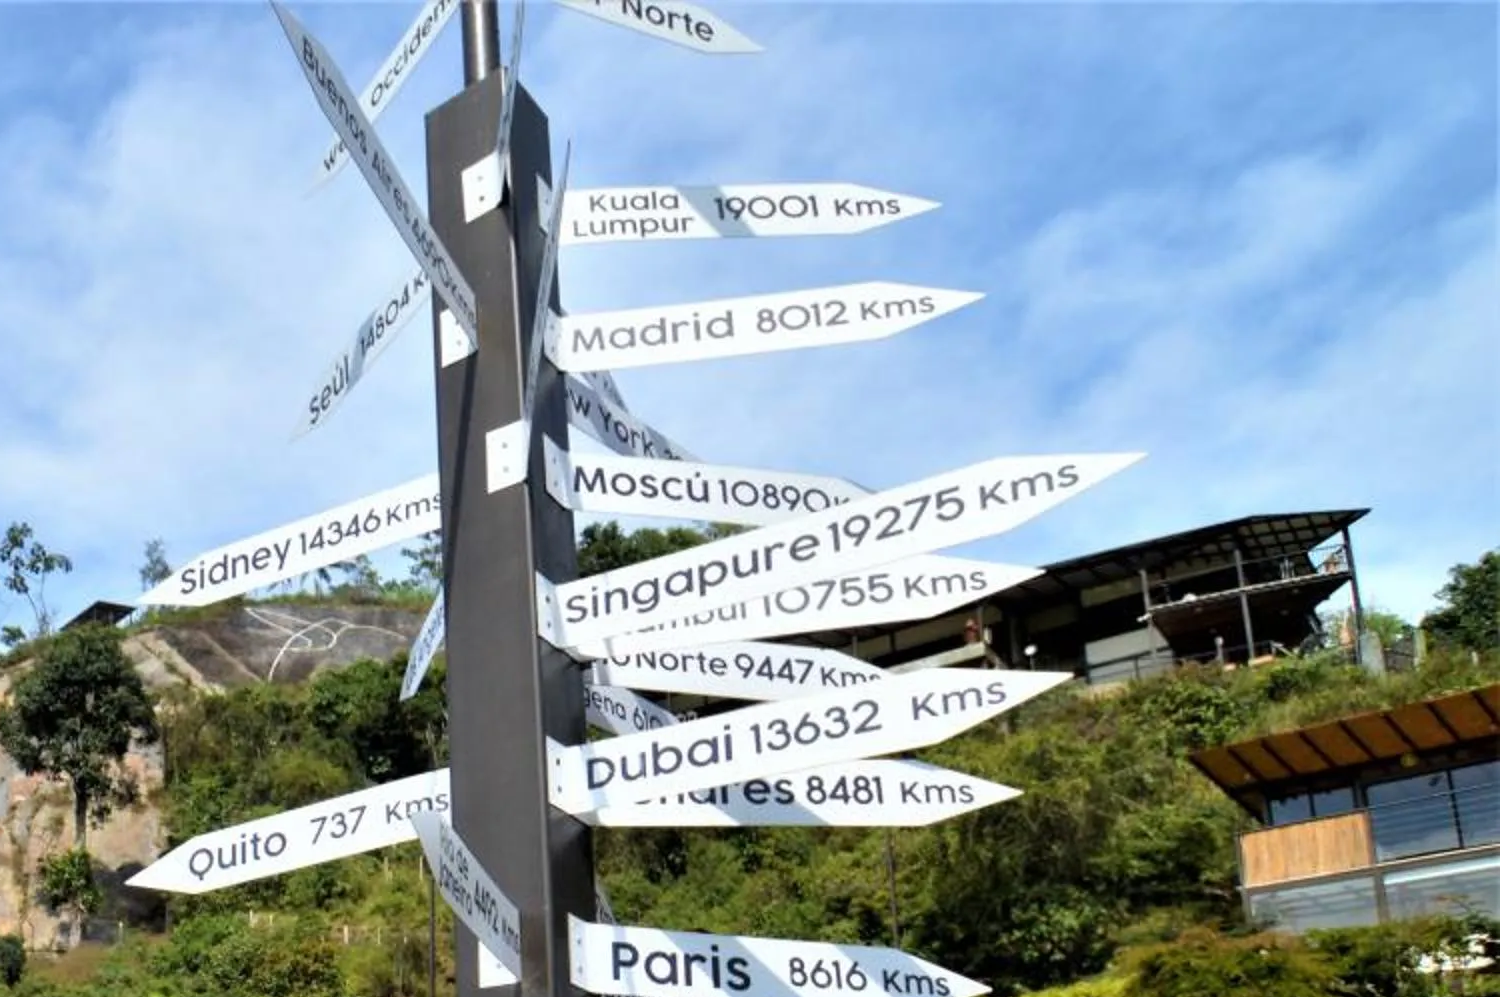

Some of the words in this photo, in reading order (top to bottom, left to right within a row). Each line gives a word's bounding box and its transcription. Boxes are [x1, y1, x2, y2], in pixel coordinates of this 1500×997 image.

[621, 0, 714, 42] Norte
[371, 0, 450, 107] Occiden
[302, 35, 368, 155] Buenos
[573, 214, 694, 238] Lumpur
[589, 194, 680, 212] Kuala
[714, 196, 818, 220] 19001
[834, 198, 900, 217] Kms
[572, 309, 735, 353] Madrid
[756, 301, 850, 334] 8012
[860, 295, 936, 322] Kms
[573, 465, 710, 503] Moscú
[718, 478, 831, 513] 10890
[179, 537, 293, 596] Sidney
[299, 506, 382, 556] 14346
[565, 532, 820, 624] Singapure
[827, 490, 965, 553] 19275
[978, 461, 1081, 511] Kms
[763, 574, 894, 618] 10755
[903, 570, 988, 600] Kms
[635, 651, 729, 677] Norte
[734, 652, 815, 685] 9447
[586, 724, 734, 790] Dubai
[749, 700, 883, 752] 13632
[911, 681, 1007, 721] Kms
[805, 775, 884, 805] 8481
[900, 783, 975, 803] Kms
[188, 831, 287, 880] Quito
[309, 806, 367, 844] 737
[384, 793, 450, 825] Kms
[611, 941, 752, 990] Paris
[788, 957, 867, 992] 8616
[882, 970, 950, 996] Kms
